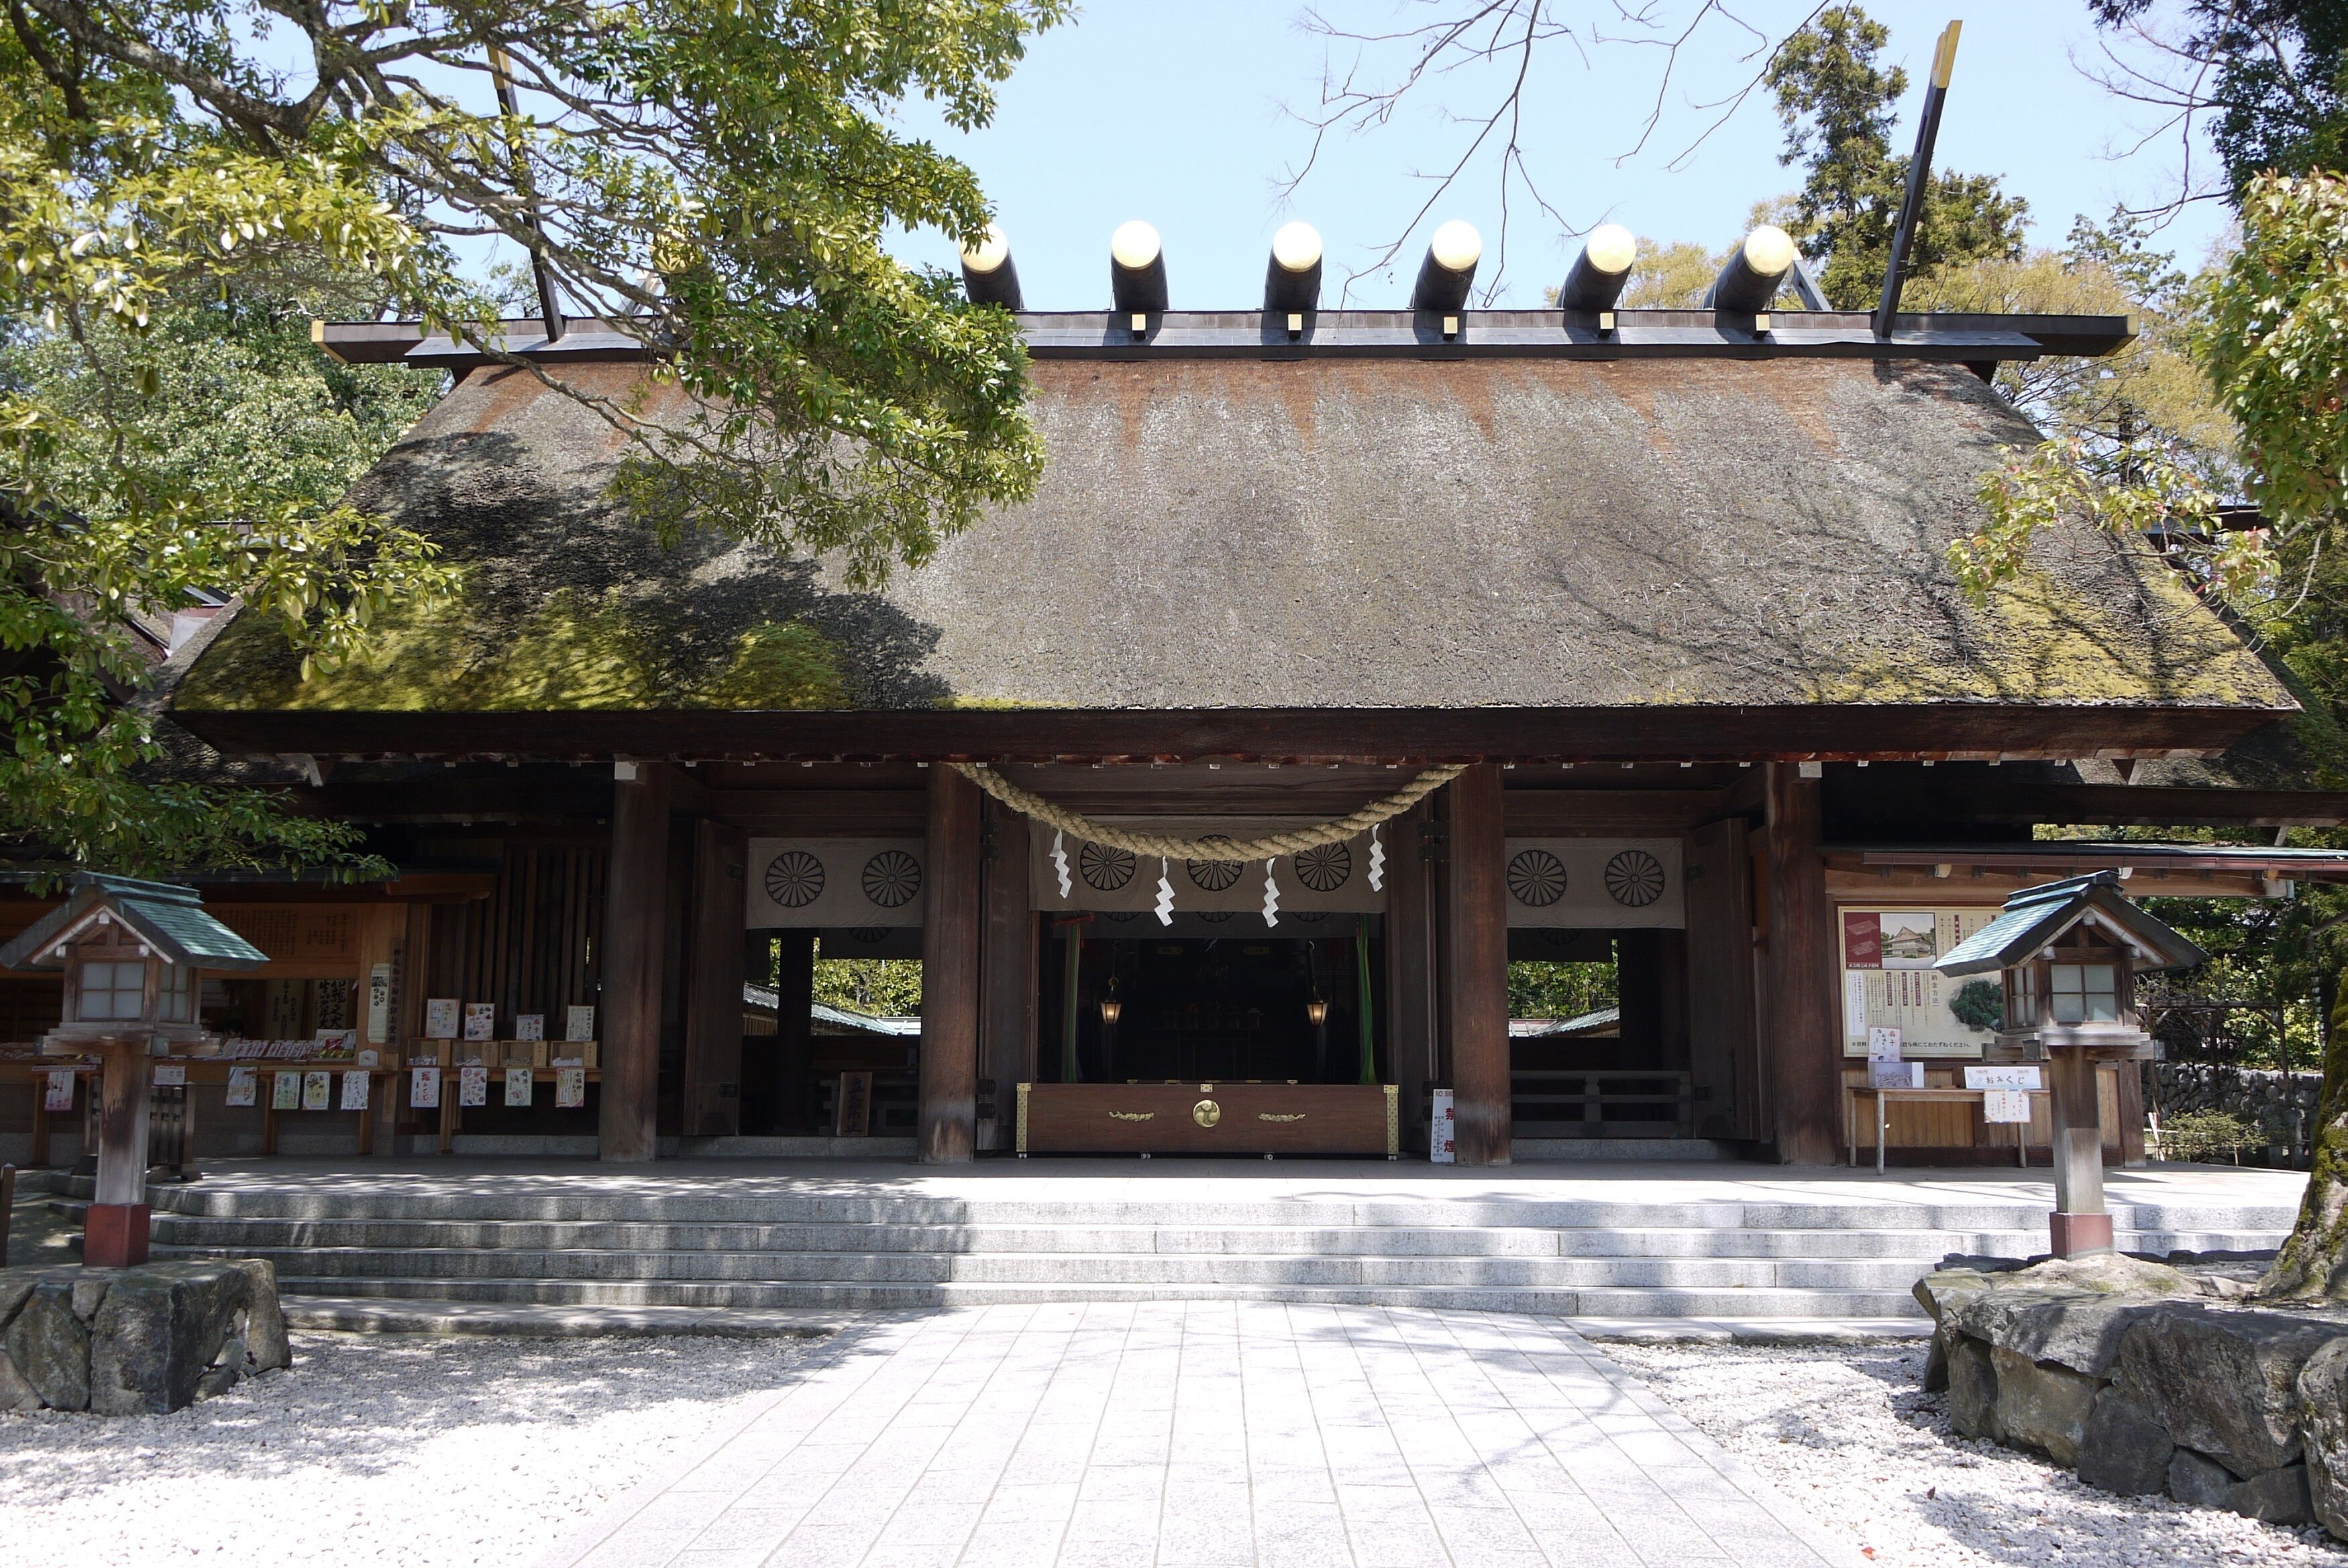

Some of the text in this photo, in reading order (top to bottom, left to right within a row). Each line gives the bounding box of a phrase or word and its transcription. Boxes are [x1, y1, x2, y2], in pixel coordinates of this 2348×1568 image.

[1986, 1075, 2025, 1084] おみくじ
[844, 1077, 865, 1133] 立入禁止
